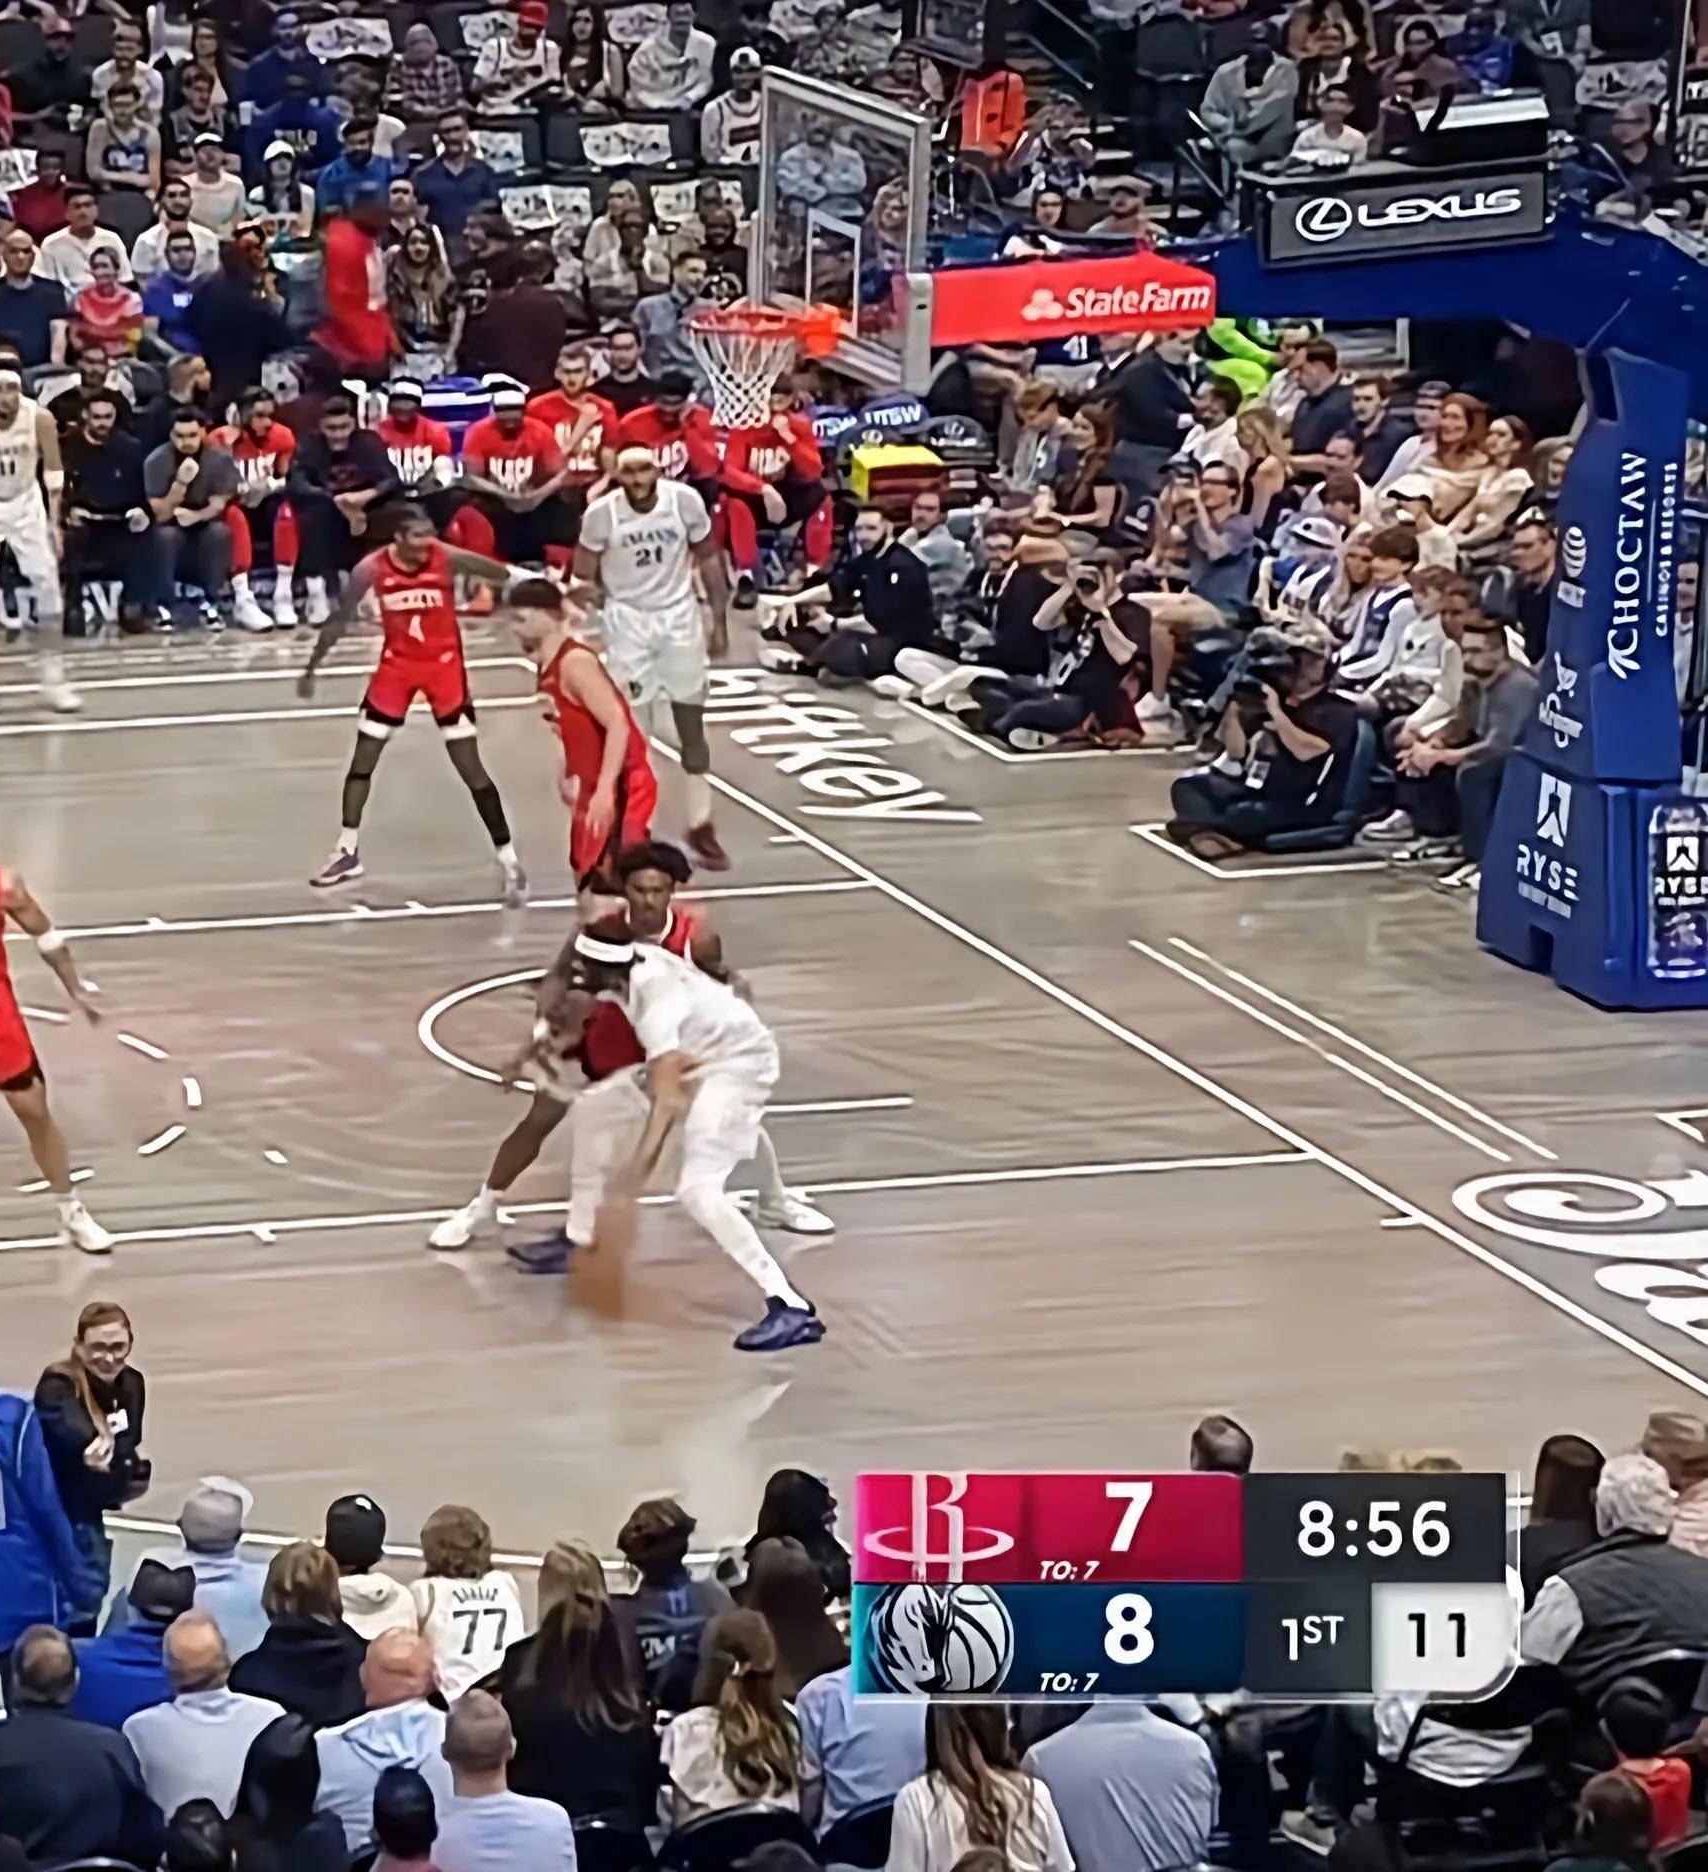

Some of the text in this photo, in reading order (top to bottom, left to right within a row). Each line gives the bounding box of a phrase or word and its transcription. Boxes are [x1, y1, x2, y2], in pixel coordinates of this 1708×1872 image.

[1357, 188, 1522, 227] LEXUS
[634, 544, 663, 568] 21
[1607, 452, 1647, 680] CHOCTAW
[407, 614, 426, 643] 4
[1516, 844, 1579, 901] RYSE
[453, 1608, 507, 1655] 77
